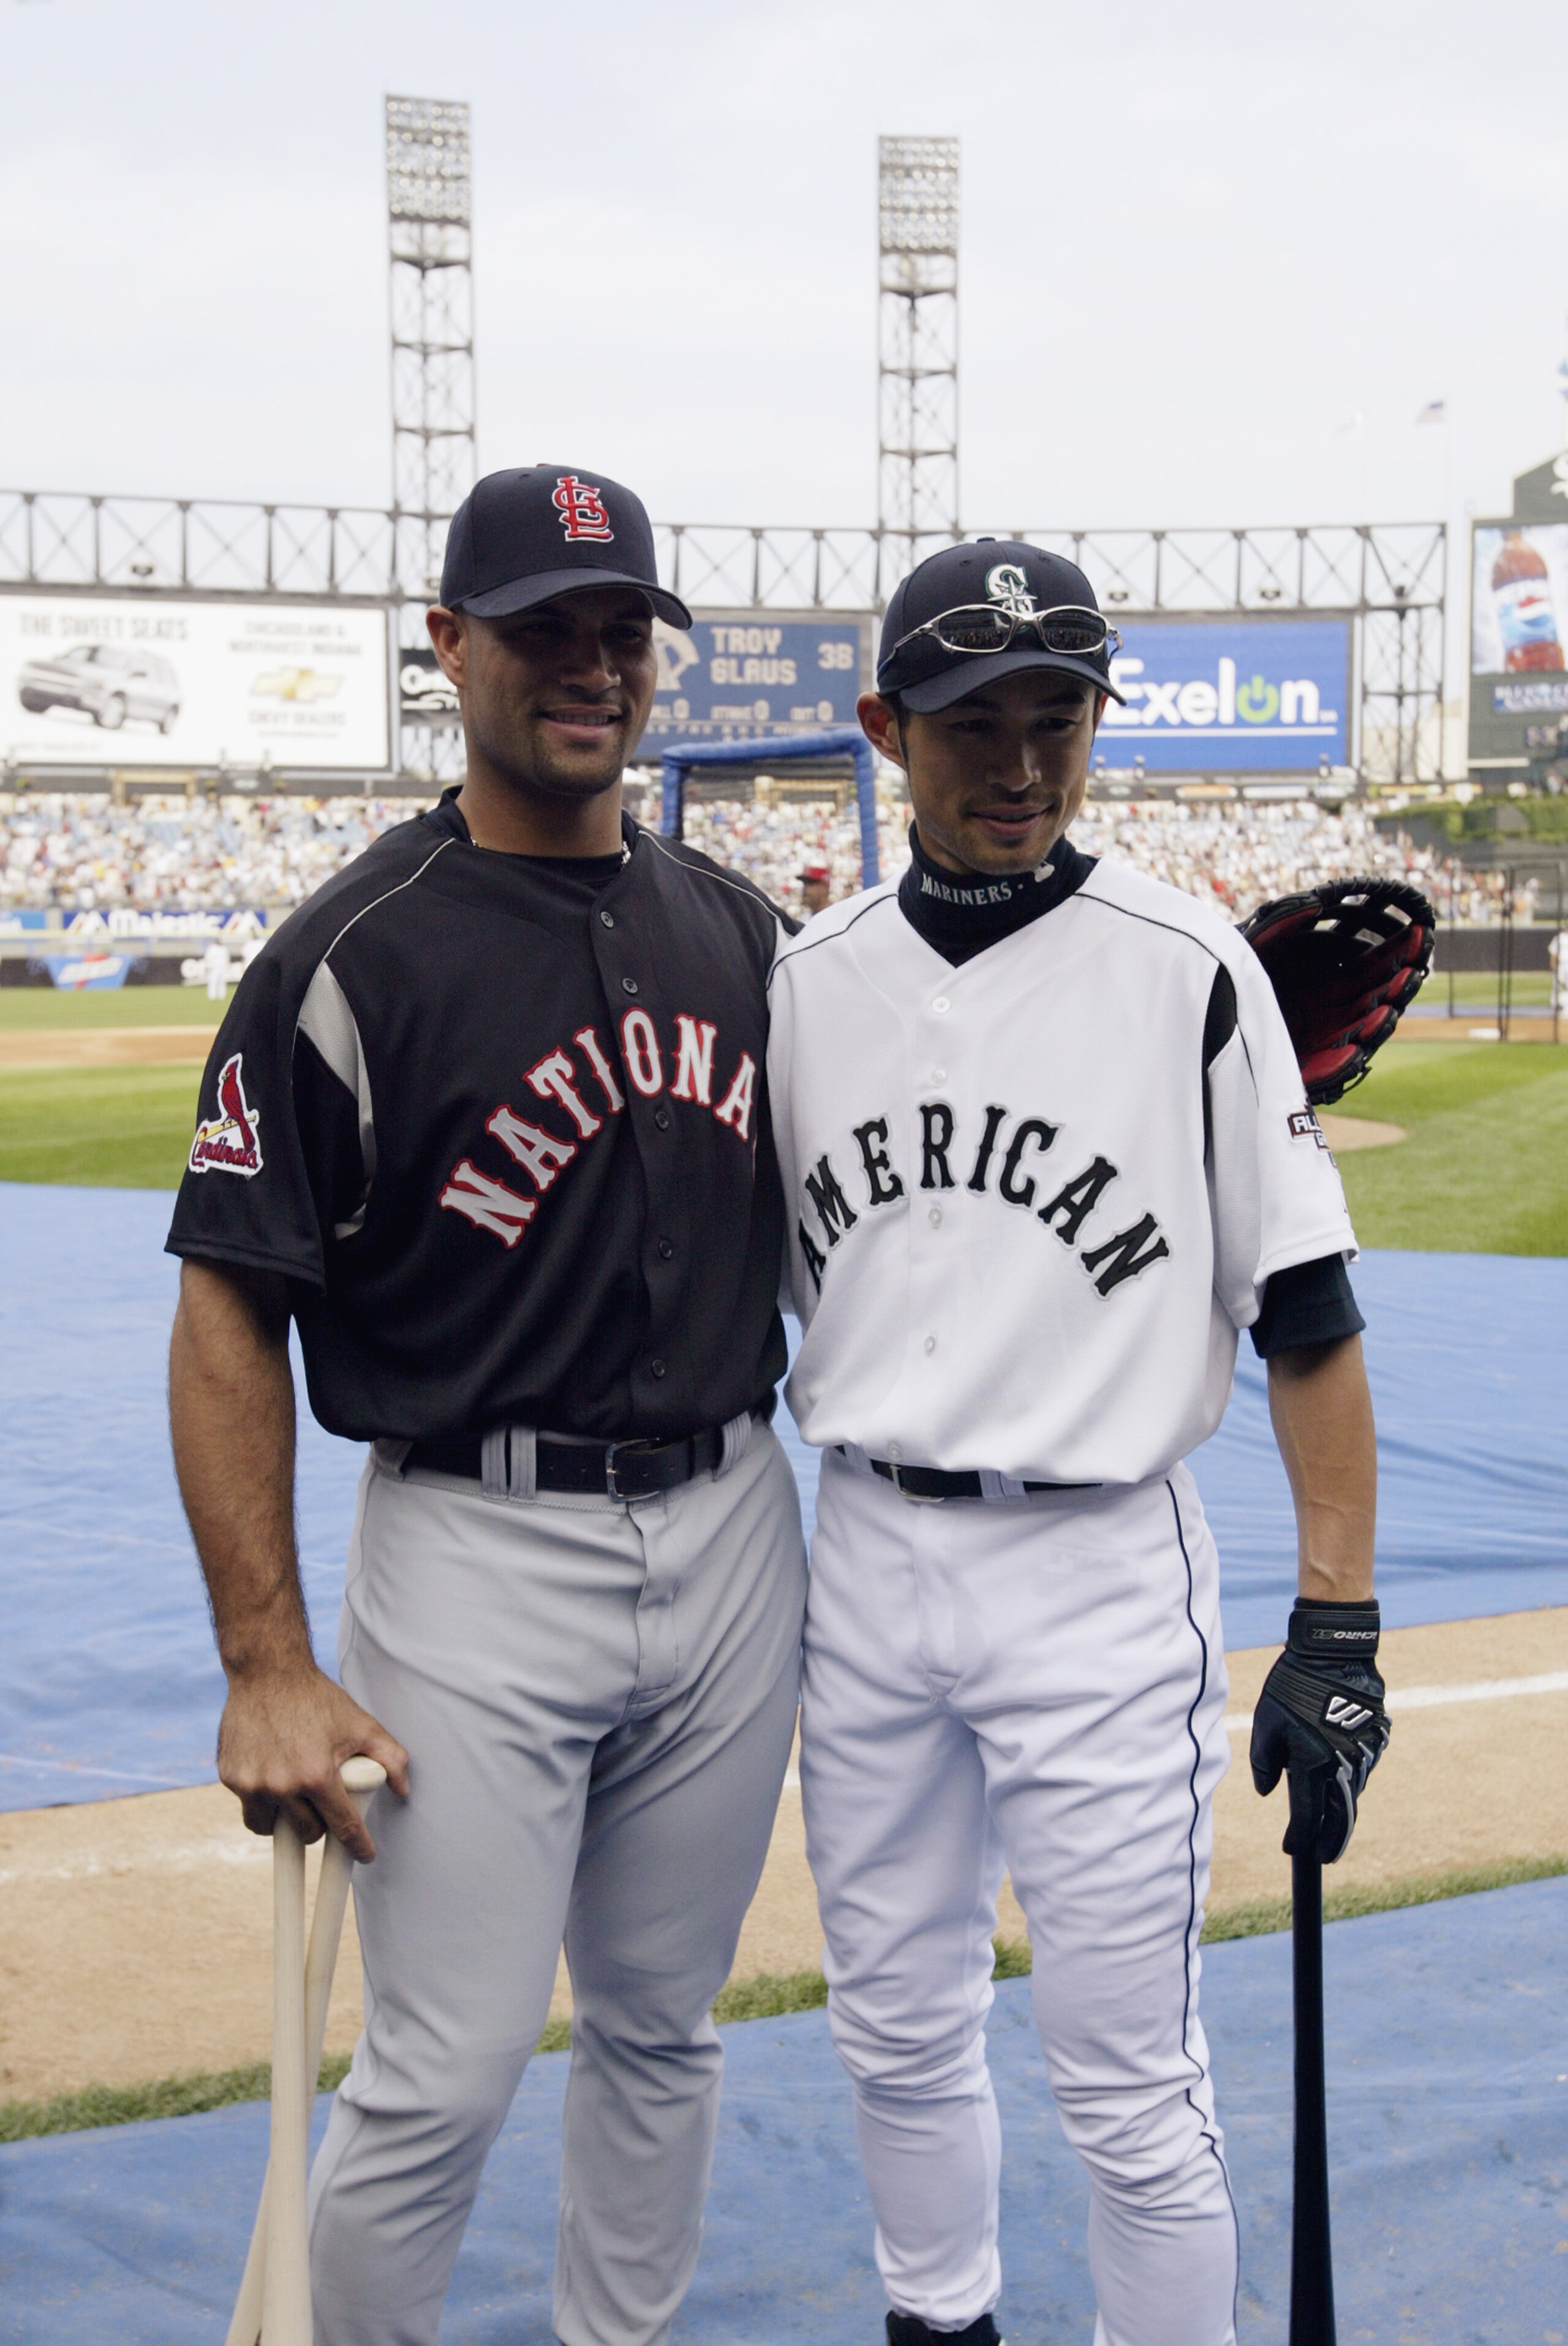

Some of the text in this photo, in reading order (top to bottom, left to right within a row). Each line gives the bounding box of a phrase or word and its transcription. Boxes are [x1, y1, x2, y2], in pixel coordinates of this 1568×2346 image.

[19, 612, 51, 635] THE
[710, 627, 782, 654] TROY
[710, 657, 797, 686] GLAUS
[1103, 657, 1319, 726] Exelon
[921, 872, 1012, 906] MARINERS
[437, 1006, 757, 1250] NATIONA
[799, 1102, 1170, 1297] AMERICAN
